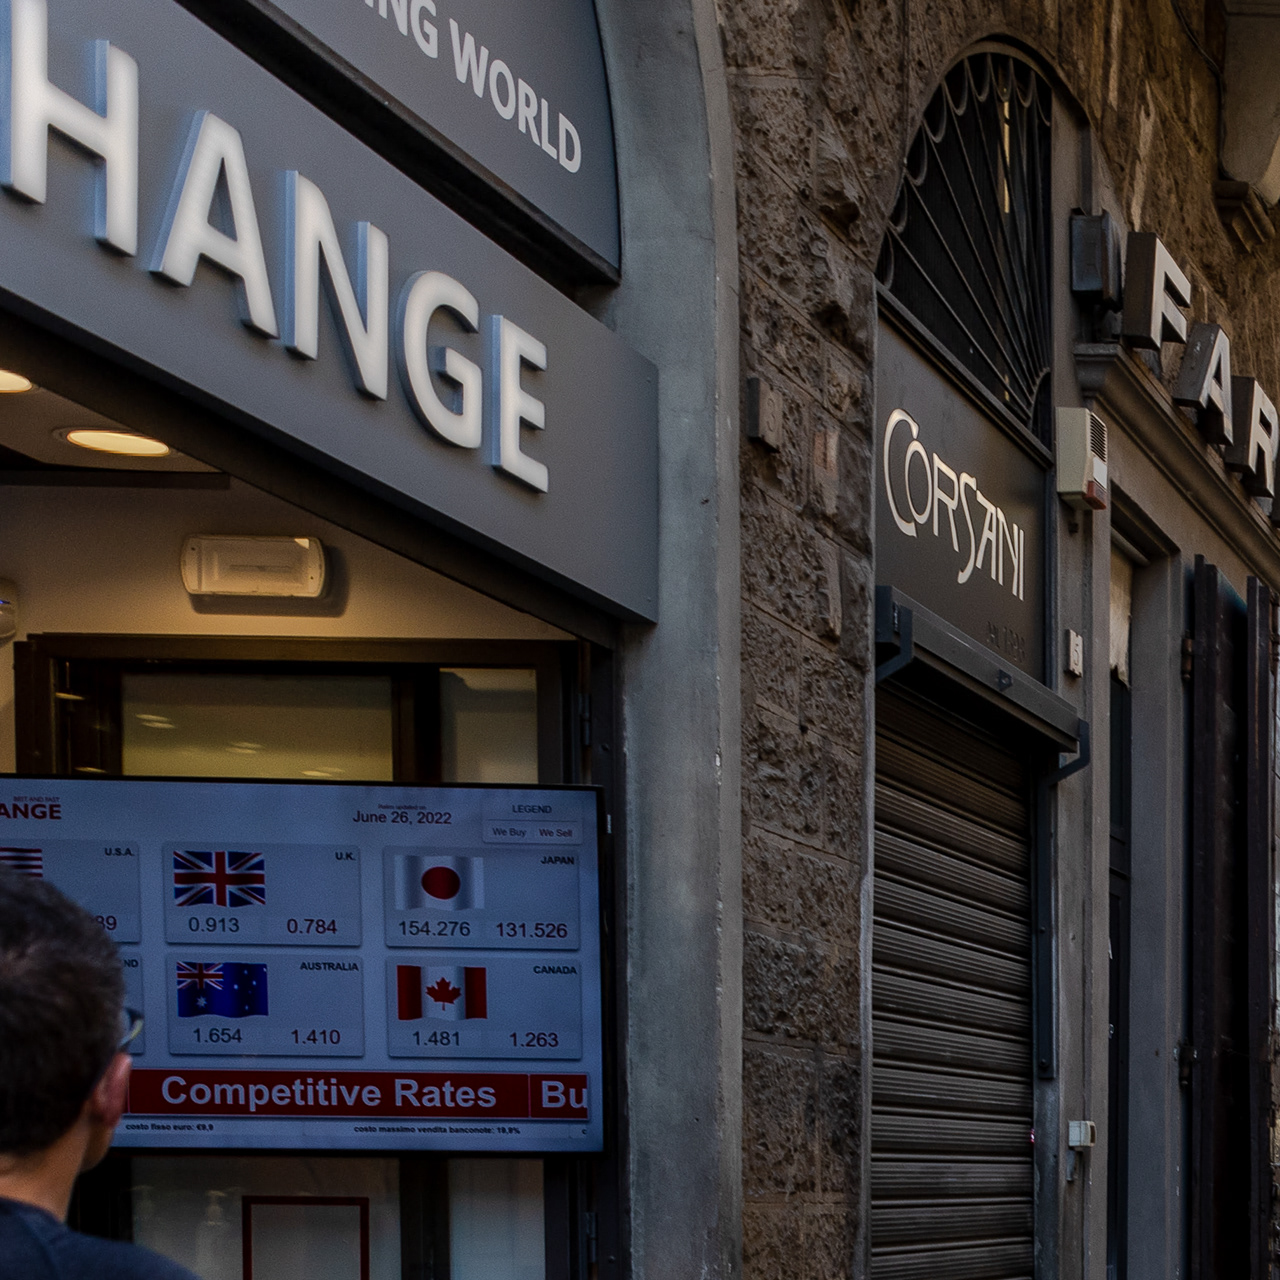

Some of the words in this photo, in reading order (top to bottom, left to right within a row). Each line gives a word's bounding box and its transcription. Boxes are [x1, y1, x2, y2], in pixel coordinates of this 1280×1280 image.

[449, 18, 581, 173] WORLD
[883, 408, 1025, 601] CORSANI
[512, 805, 552, 814] LEGEND
[353, 811, 387, 823] June
[391, 811, 413, 824] 26,
[417, 812, 452, 824] 2022
[493, 828, 509, 837] We
[510, 828, 526, 838] Buy
[539, 828, 554, 837] We
[556, 829, 572, 838] Sell
[104, 847, 135, 857] U.S.A.
[335, 852, 356, 860] U.K.
[540, 857, 574, 865] JAPAN
[188, 917, 239, 933] 0.913
[287, 919, 337, 934] 0.784
[399, 921, 471, 937] 154.276
[496, 922, 568, 938] 131.526
[123, 959, 138, 968] ND
[300, 962, 359, 971] AUSTRALIA
[533, 966, 577, 975] CANADA
[193, 1028, 243, 1043] 1.654
[291, 1029, 341, 1044] 1.410
[413, 1031, 460, 1046] 1.481
[510, 1032, 558, 1047] 1.263
[161, 1076, 382, 1112] Competitive
[394, 1079, 496, 1108] Rates
